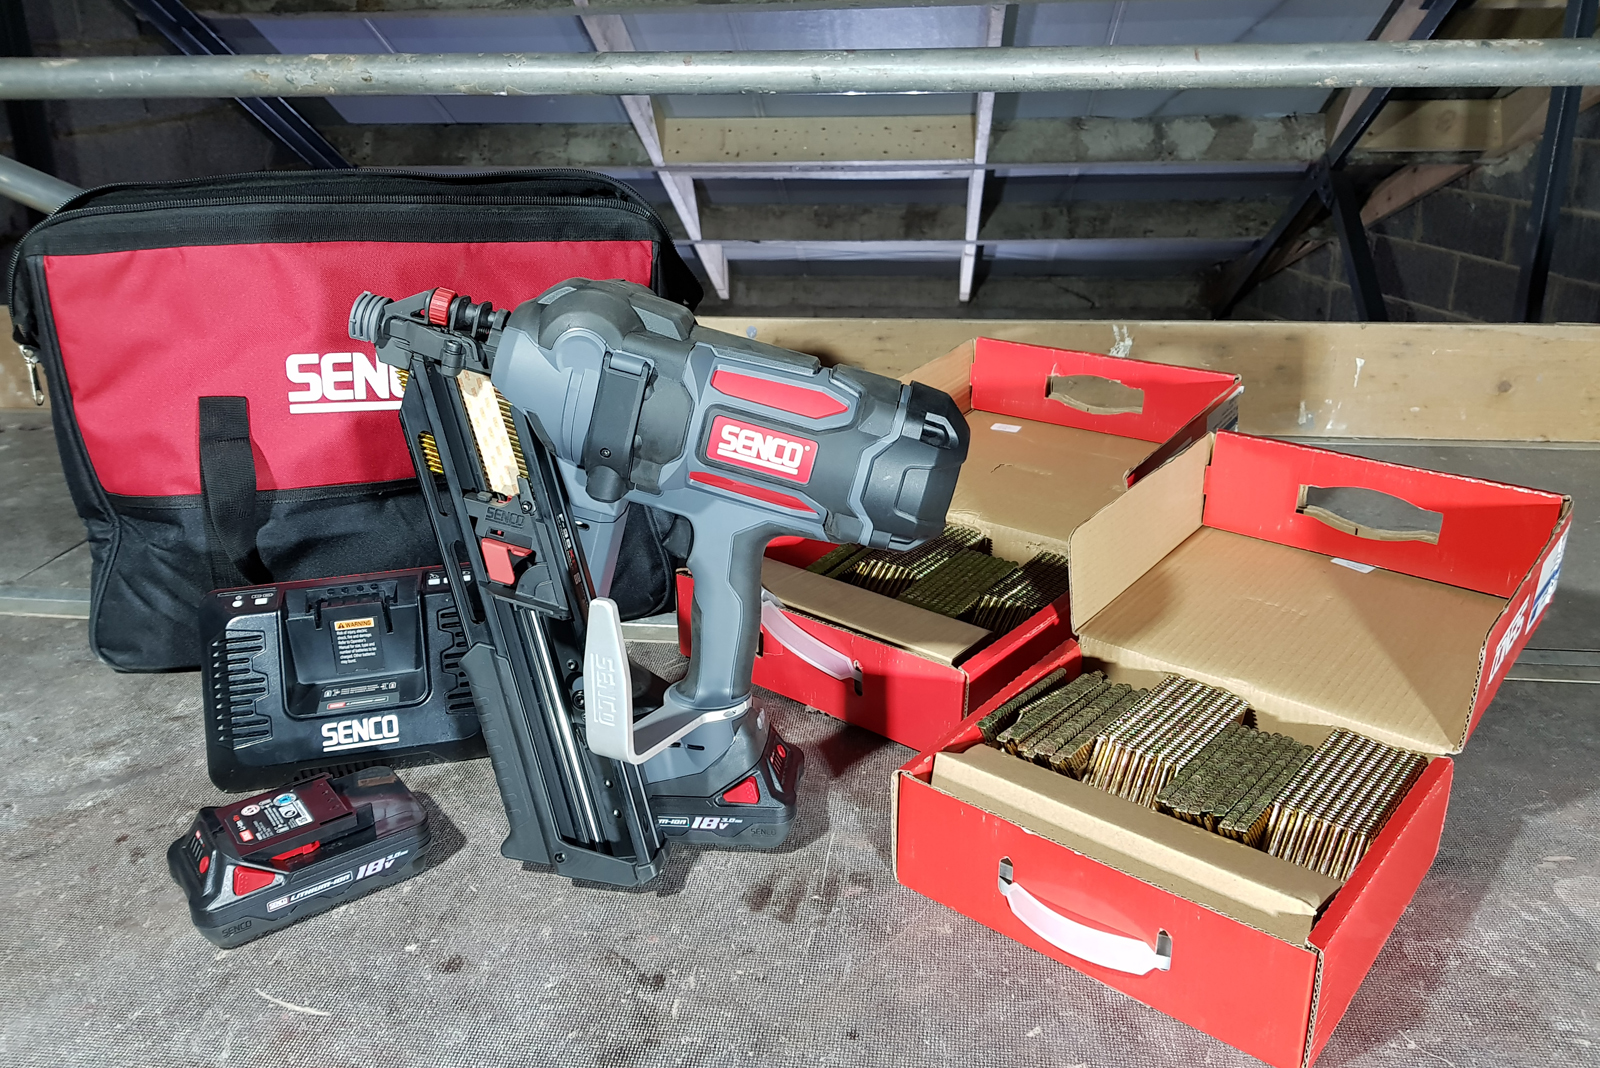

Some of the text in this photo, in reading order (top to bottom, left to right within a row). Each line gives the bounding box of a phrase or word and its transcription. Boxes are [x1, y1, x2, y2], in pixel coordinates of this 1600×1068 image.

[718, 424, 804, 469] SENCO
[485, 506, 525, 527] SENCO
[345, 619, 372, 628] WARNING
[596, 654, 617, 727] SENCO
[321, 714, 400, 747] SENCO
[221, 920, 253, 938] SENCO
